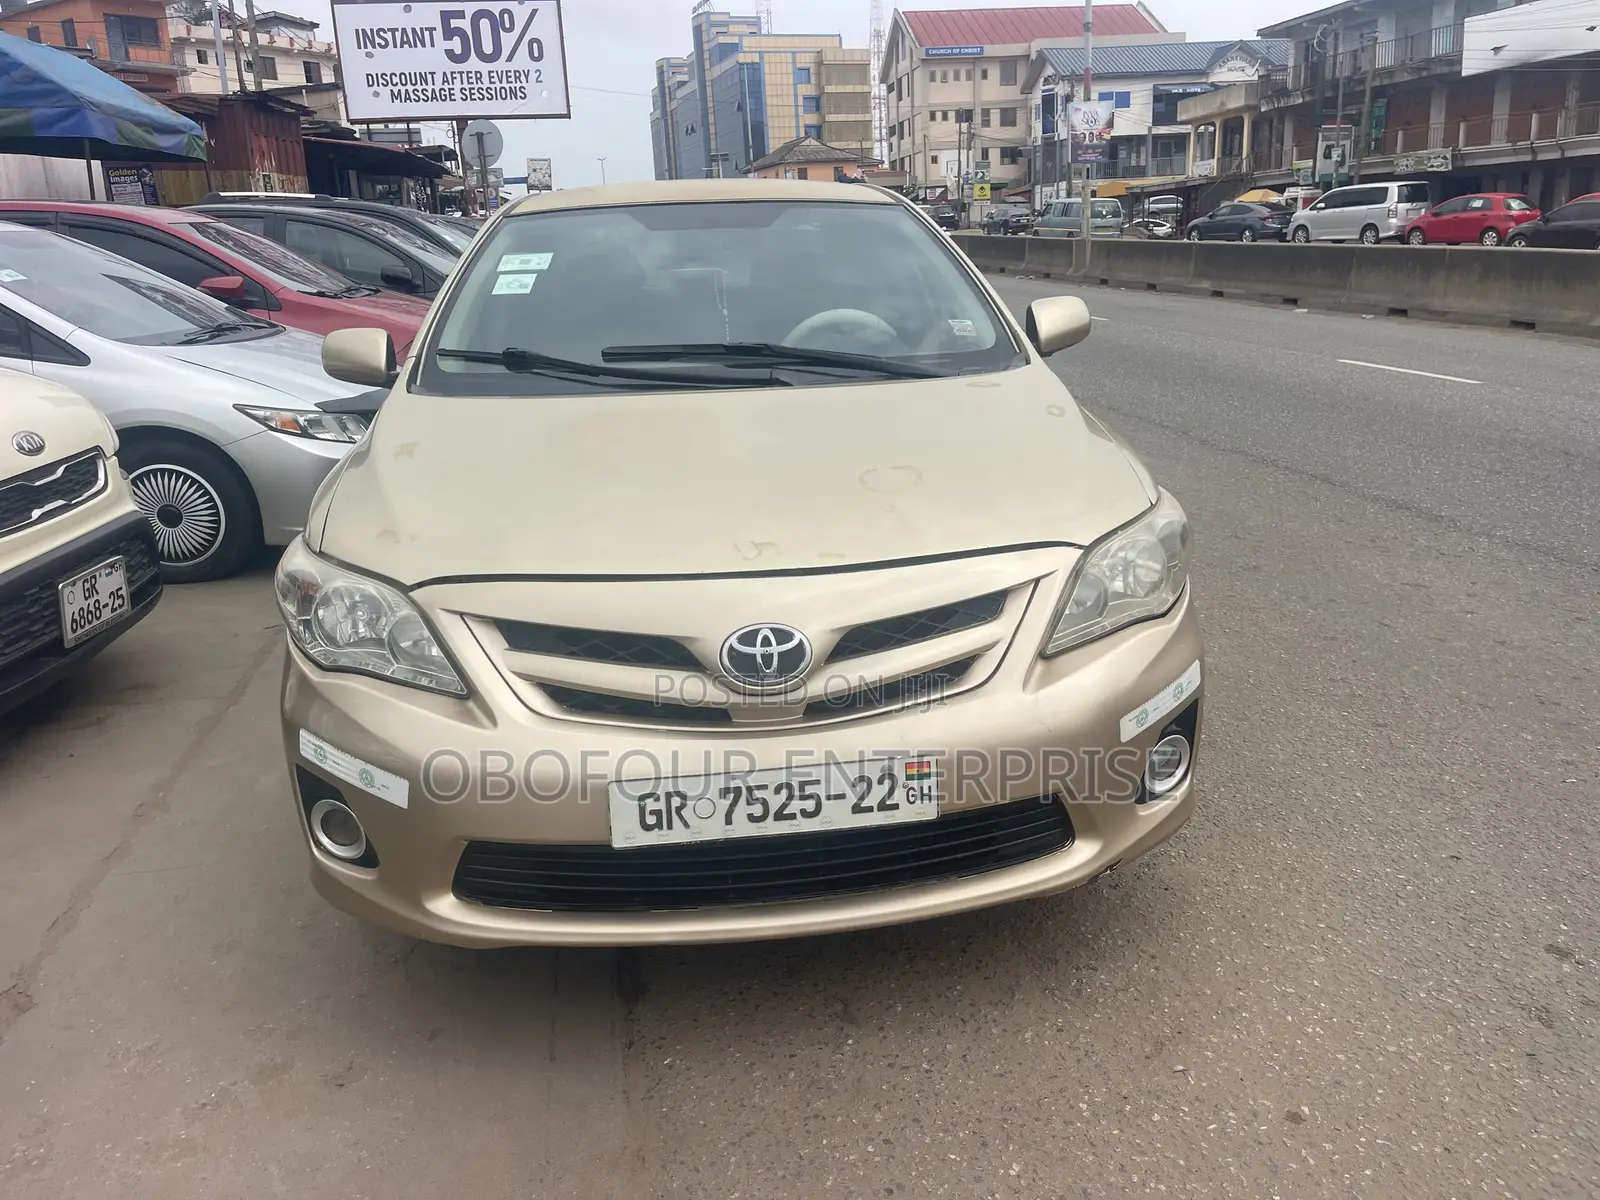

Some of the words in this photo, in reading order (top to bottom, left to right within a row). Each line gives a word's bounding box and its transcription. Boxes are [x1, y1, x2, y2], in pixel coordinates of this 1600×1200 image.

[355, 27, 436, 49] INSTANT
[439, 8, 544, 64] 50%
[366, 71, 436, 87] DISCOUNT
[441, 70, 483, 86] AFTER
[488, 69, 530, 85] EVERY
[534, 69, 543, 83] 2
[390, 87, 456, 103] MASSAGE
[460, 86, 527, 101] SESSIONS
[109, 168, 137, 176] Golden
[110, 175, 138, 183] Images
[18, 434, 44, 451] KIA
[82, 574, 99, 601] GR
[70, 586, 125, 634] 6868-25
[638, 790, 691, 832] GR
[719, 772, 899, 826] 7525-22
[905, 784, 933, 805] GH
